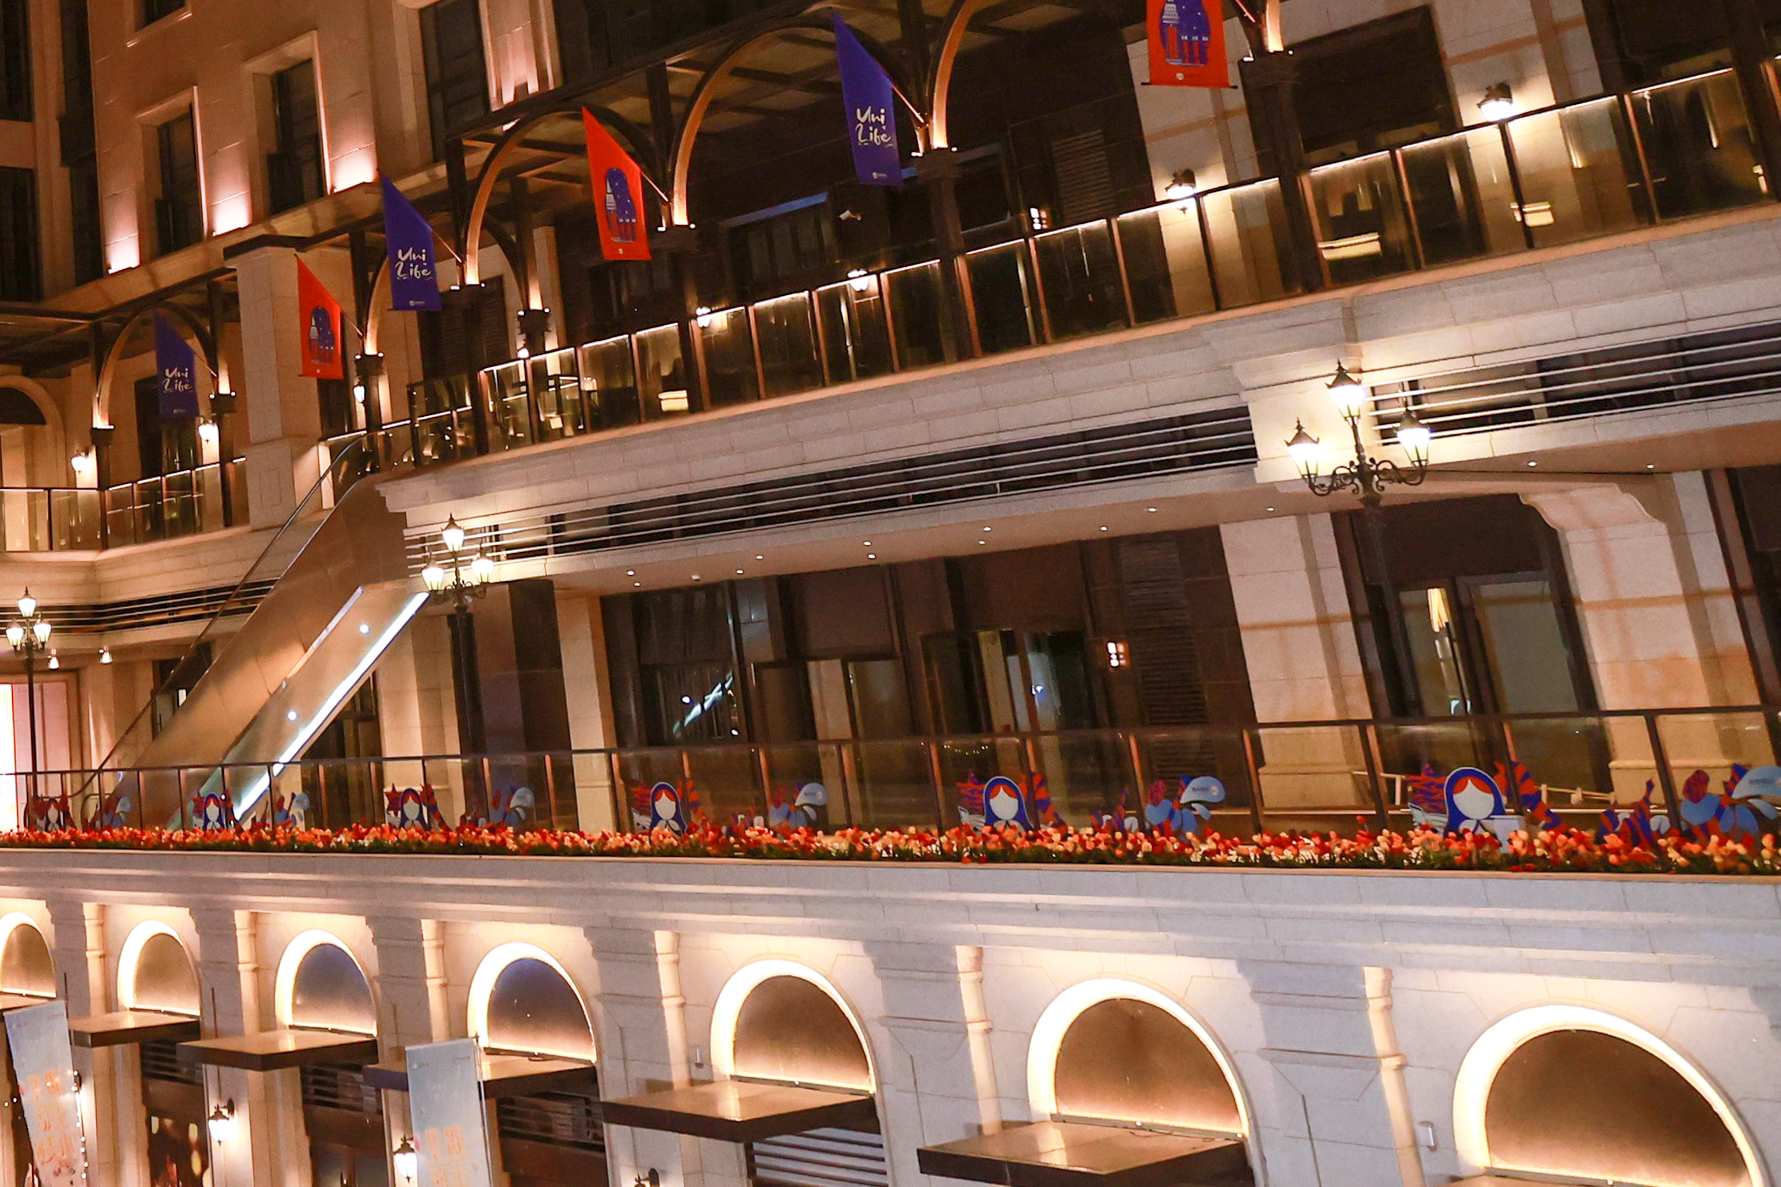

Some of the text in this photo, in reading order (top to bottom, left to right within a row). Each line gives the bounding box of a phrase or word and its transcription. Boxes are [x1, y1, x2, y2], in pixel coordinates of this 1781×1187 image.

[856, 105, 886, 125] Uni
[855, 123, 893, 146] Life
[397, 246, 427, 262] Uni
[394, 261, 432, 280] Life
[165, 367, 189, 379] Uni
